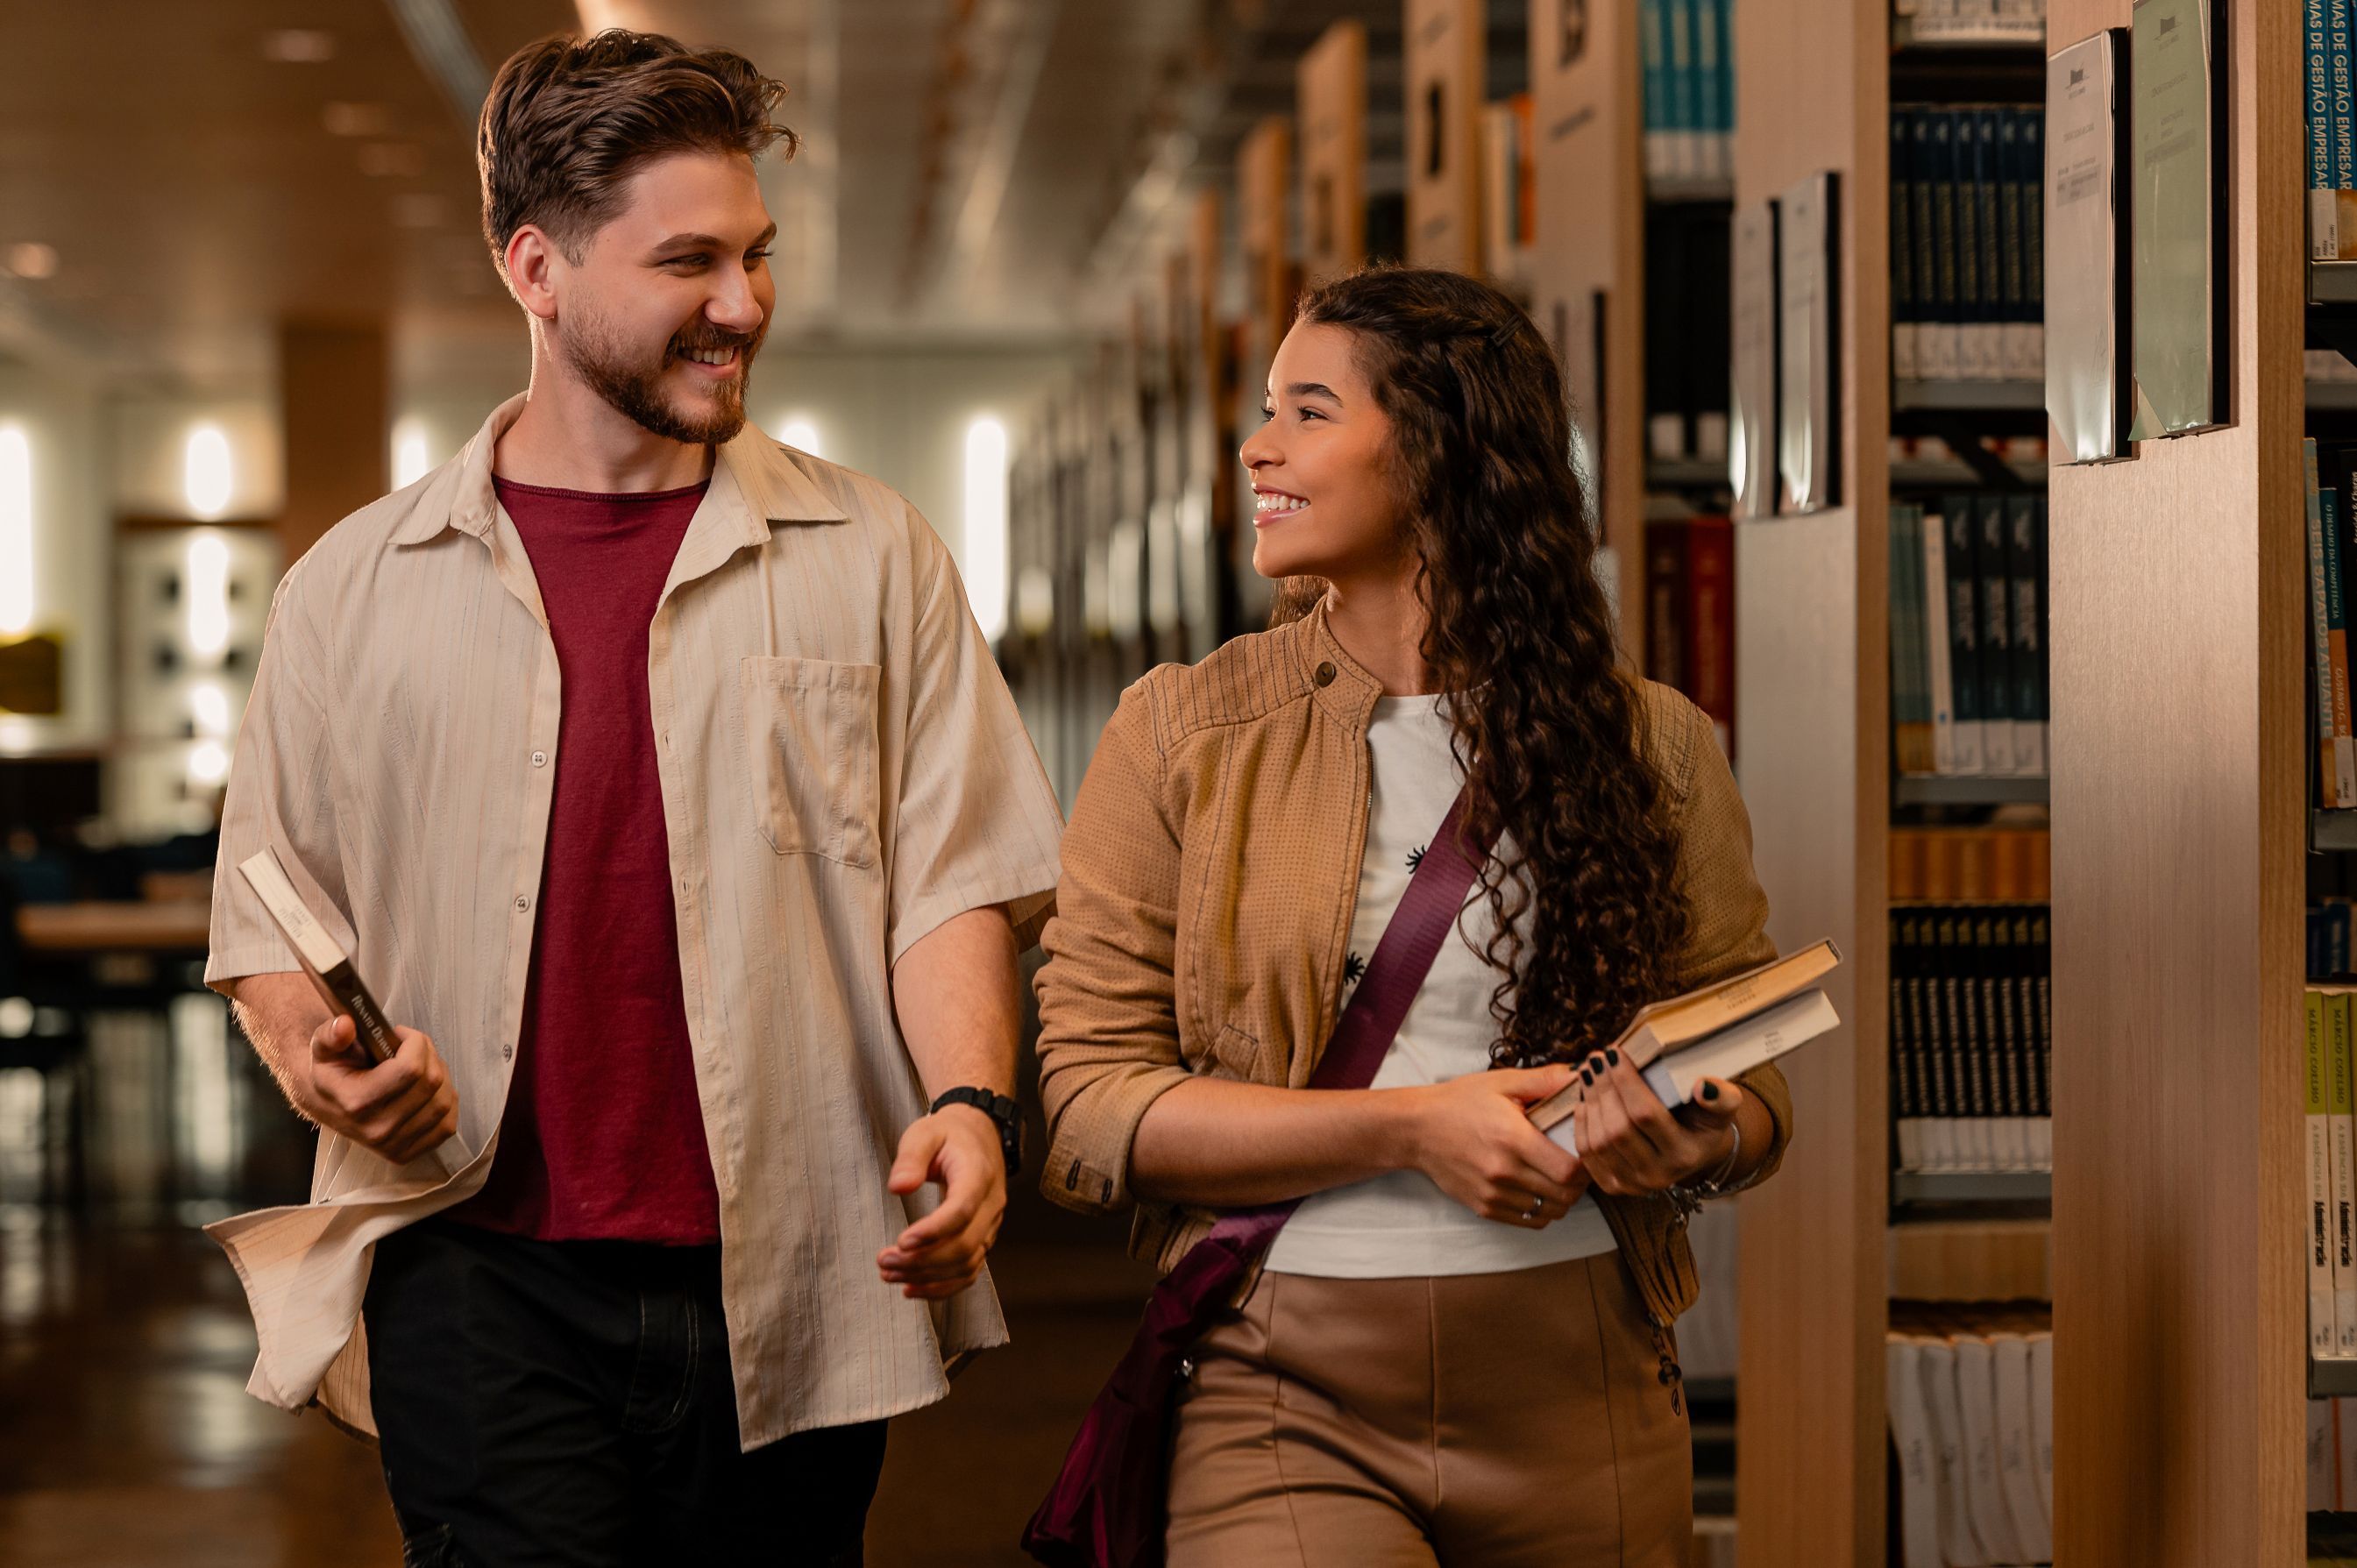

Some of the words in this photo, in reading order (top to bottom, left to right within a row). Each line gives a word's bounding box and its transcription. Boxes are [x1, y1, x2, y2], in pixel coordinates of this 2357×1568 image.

[2310, 32, 2324, 51] DE
[2332, 32, 2347, 51] DE
[2311, 54, 2328, 113] GESTÃO
[2333, 54, 2351, 113] GESTÃO
[2313, 117, 2329, 190] EMPRESAR
[2336, 117, 2353, 190] EMPRESAR
[2311, 519, 2324, 559] SEIS
[2325, 513, 2335, 548] DESAFIO
[2328, 549, 2336, 560] DA
[2314, 565, 2329, 649] SAPATOS
[2319, 652, 2333, 738] ATUANTE
[2309, 1009, 2318, 1054] MÁRCIO
[2333, 1009, 2345, 1054] MÁRCIO
[2310, 1057, 2319, 1103] COELHO
[2335, 1057, 2345, 1103] COELHO
[2314, 1200, 2326, 1267] Administração
[2339, 1200, 2352, 1267] Administração
